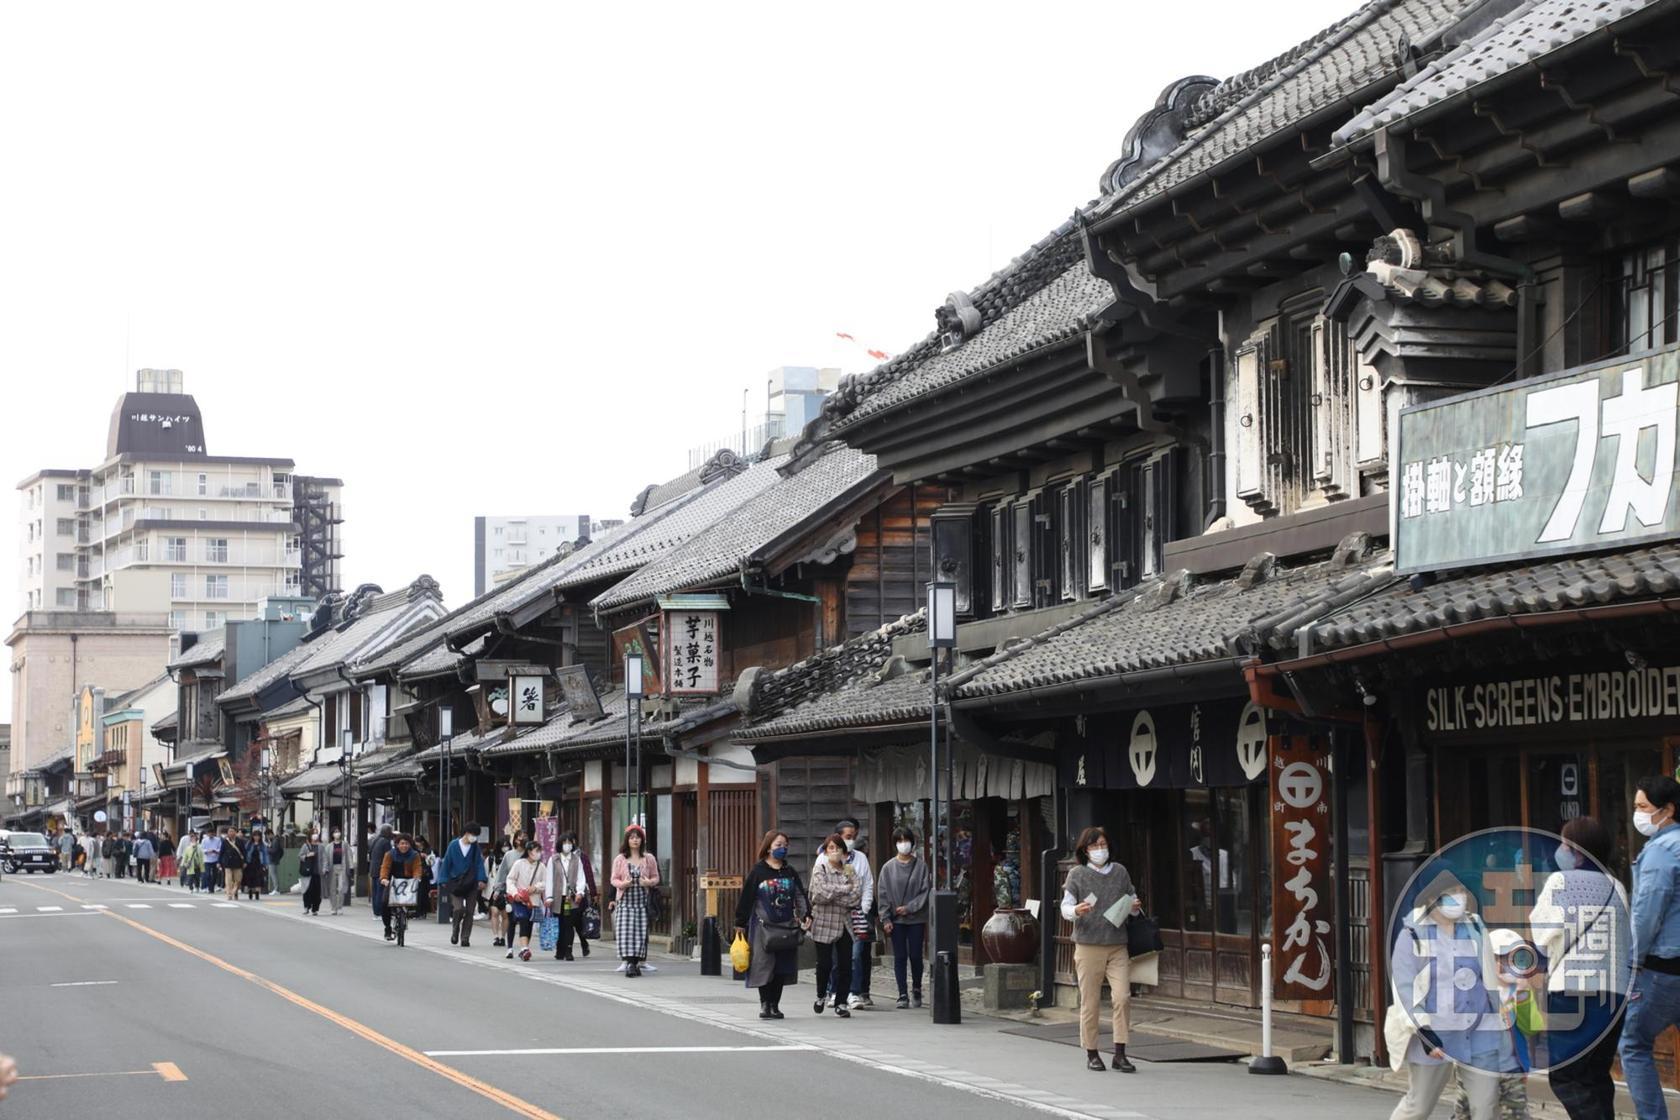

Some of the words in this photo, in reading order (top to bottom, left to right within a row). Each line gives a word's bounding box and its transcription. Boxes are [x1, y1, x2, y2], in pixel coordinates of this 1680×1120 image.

[685, 615, 702, 688] 芋菓子
[703, 618, 714, 668] 川越名物
[1282, 818, 1331, 991] まちかん
